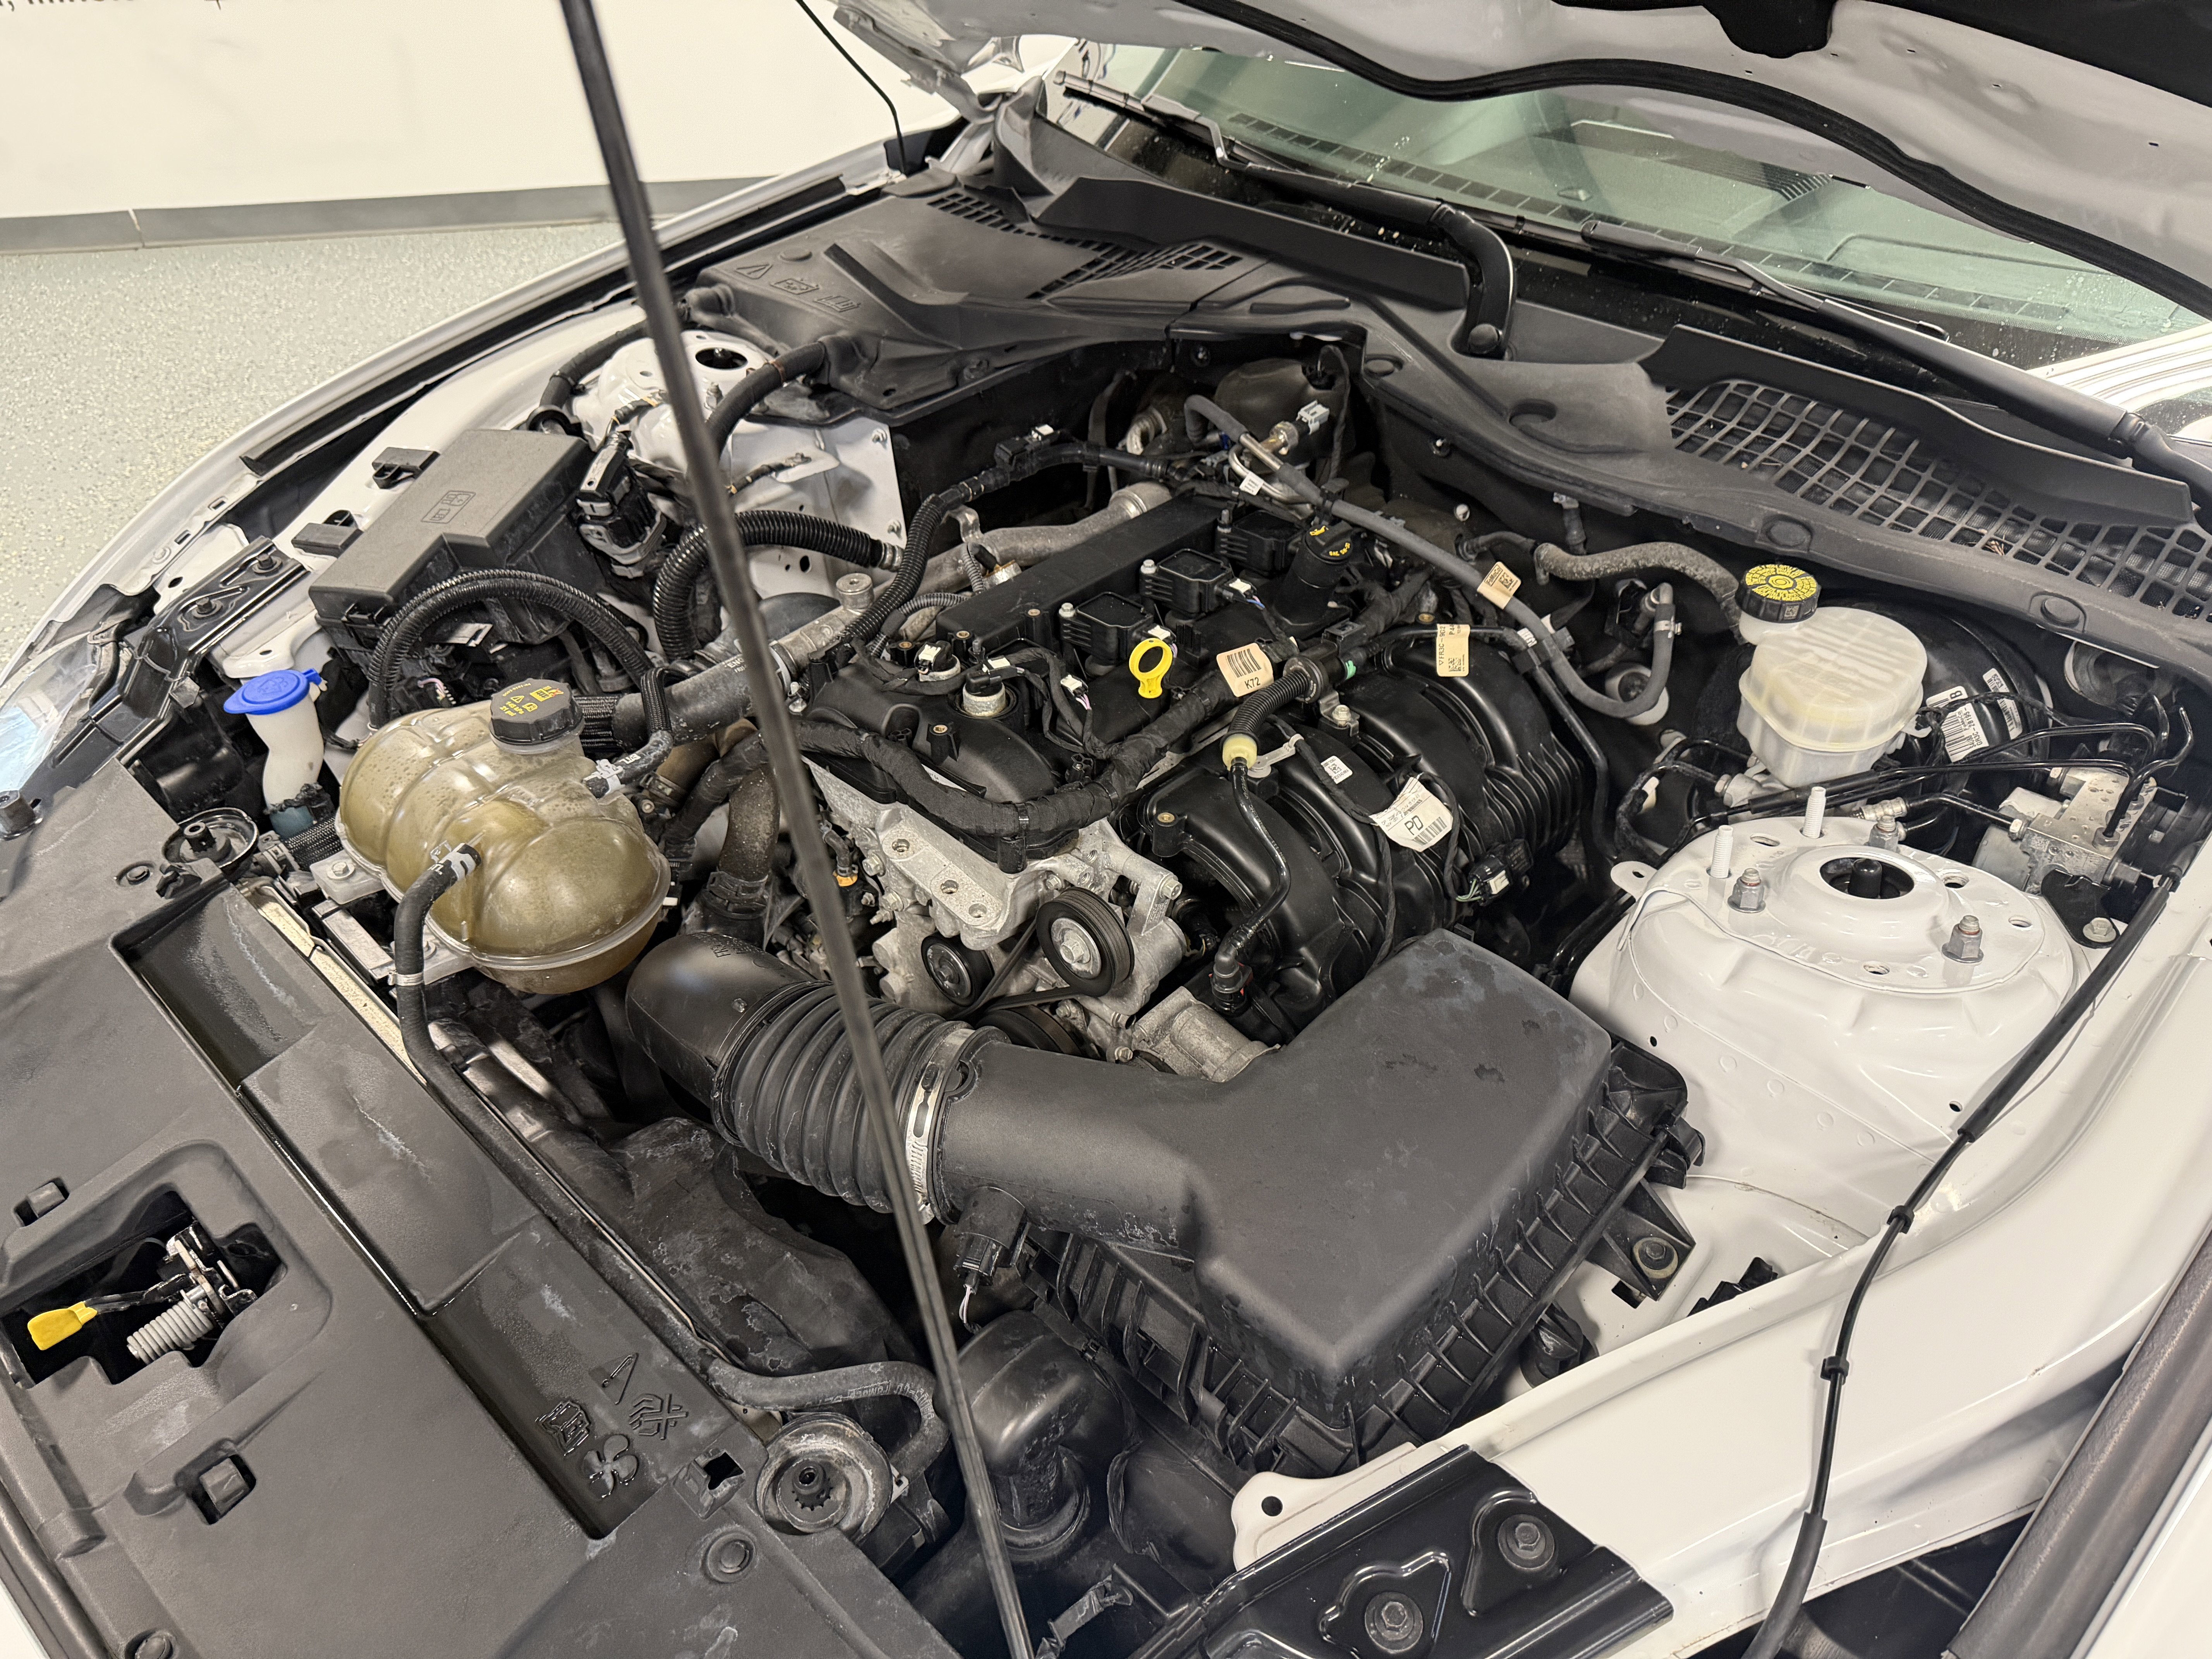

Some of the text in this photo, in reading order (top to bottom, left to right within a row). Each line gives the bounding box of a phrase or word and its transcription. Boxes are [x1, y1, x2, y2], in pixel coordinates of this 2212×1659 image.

[1244, 677, 1261, 689] K72
[1949, 690, 1963, 699] B
[1404, 815, 1424, 836] PD
